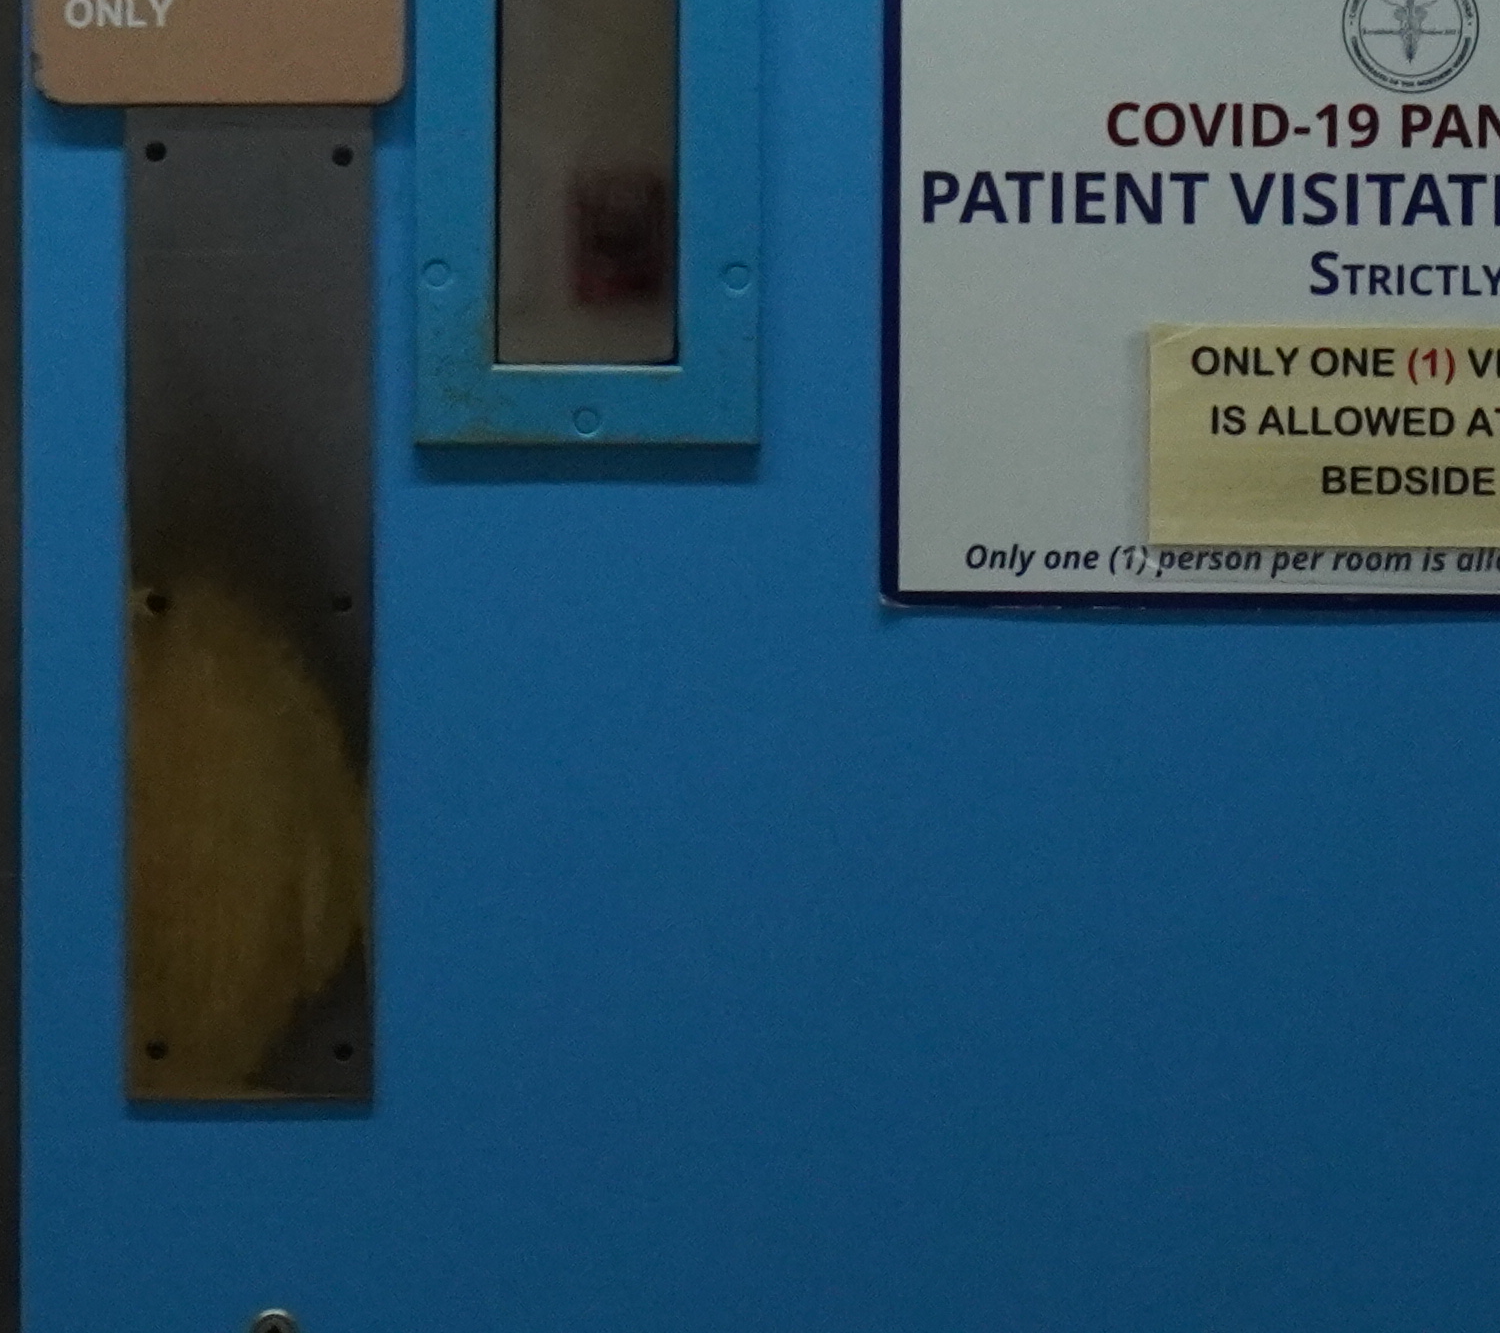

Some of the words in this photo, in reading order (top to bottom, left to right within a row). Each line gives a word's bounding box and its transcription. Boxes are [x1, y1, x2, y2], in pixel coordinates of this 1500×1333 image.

[1107, 102, 1379, 148] COVID-19
[923, 171, 1209, 225] PATIENT
[1191, 346, 1299, 376] ONLY
[1310, 347, 1395, 377] ONE
[1408, 348, 1455, 385] (1)
[1212, 405, 1246, 436] IS
[1258, 405, 1455, 437] ALLOWED
[1322, 466, 1495, 496] BEDSIDE
[966, 544, 1034, 576] Only
[1043, 550, 1099, 570] one
[1109, 544, 1149, 574] (1)
[1156, 549, 1262, 578] person
[1270, 550, 1323, 578] per
[1332, 550, 1413, 572] room
[1422, 548, 1446, 572] is
